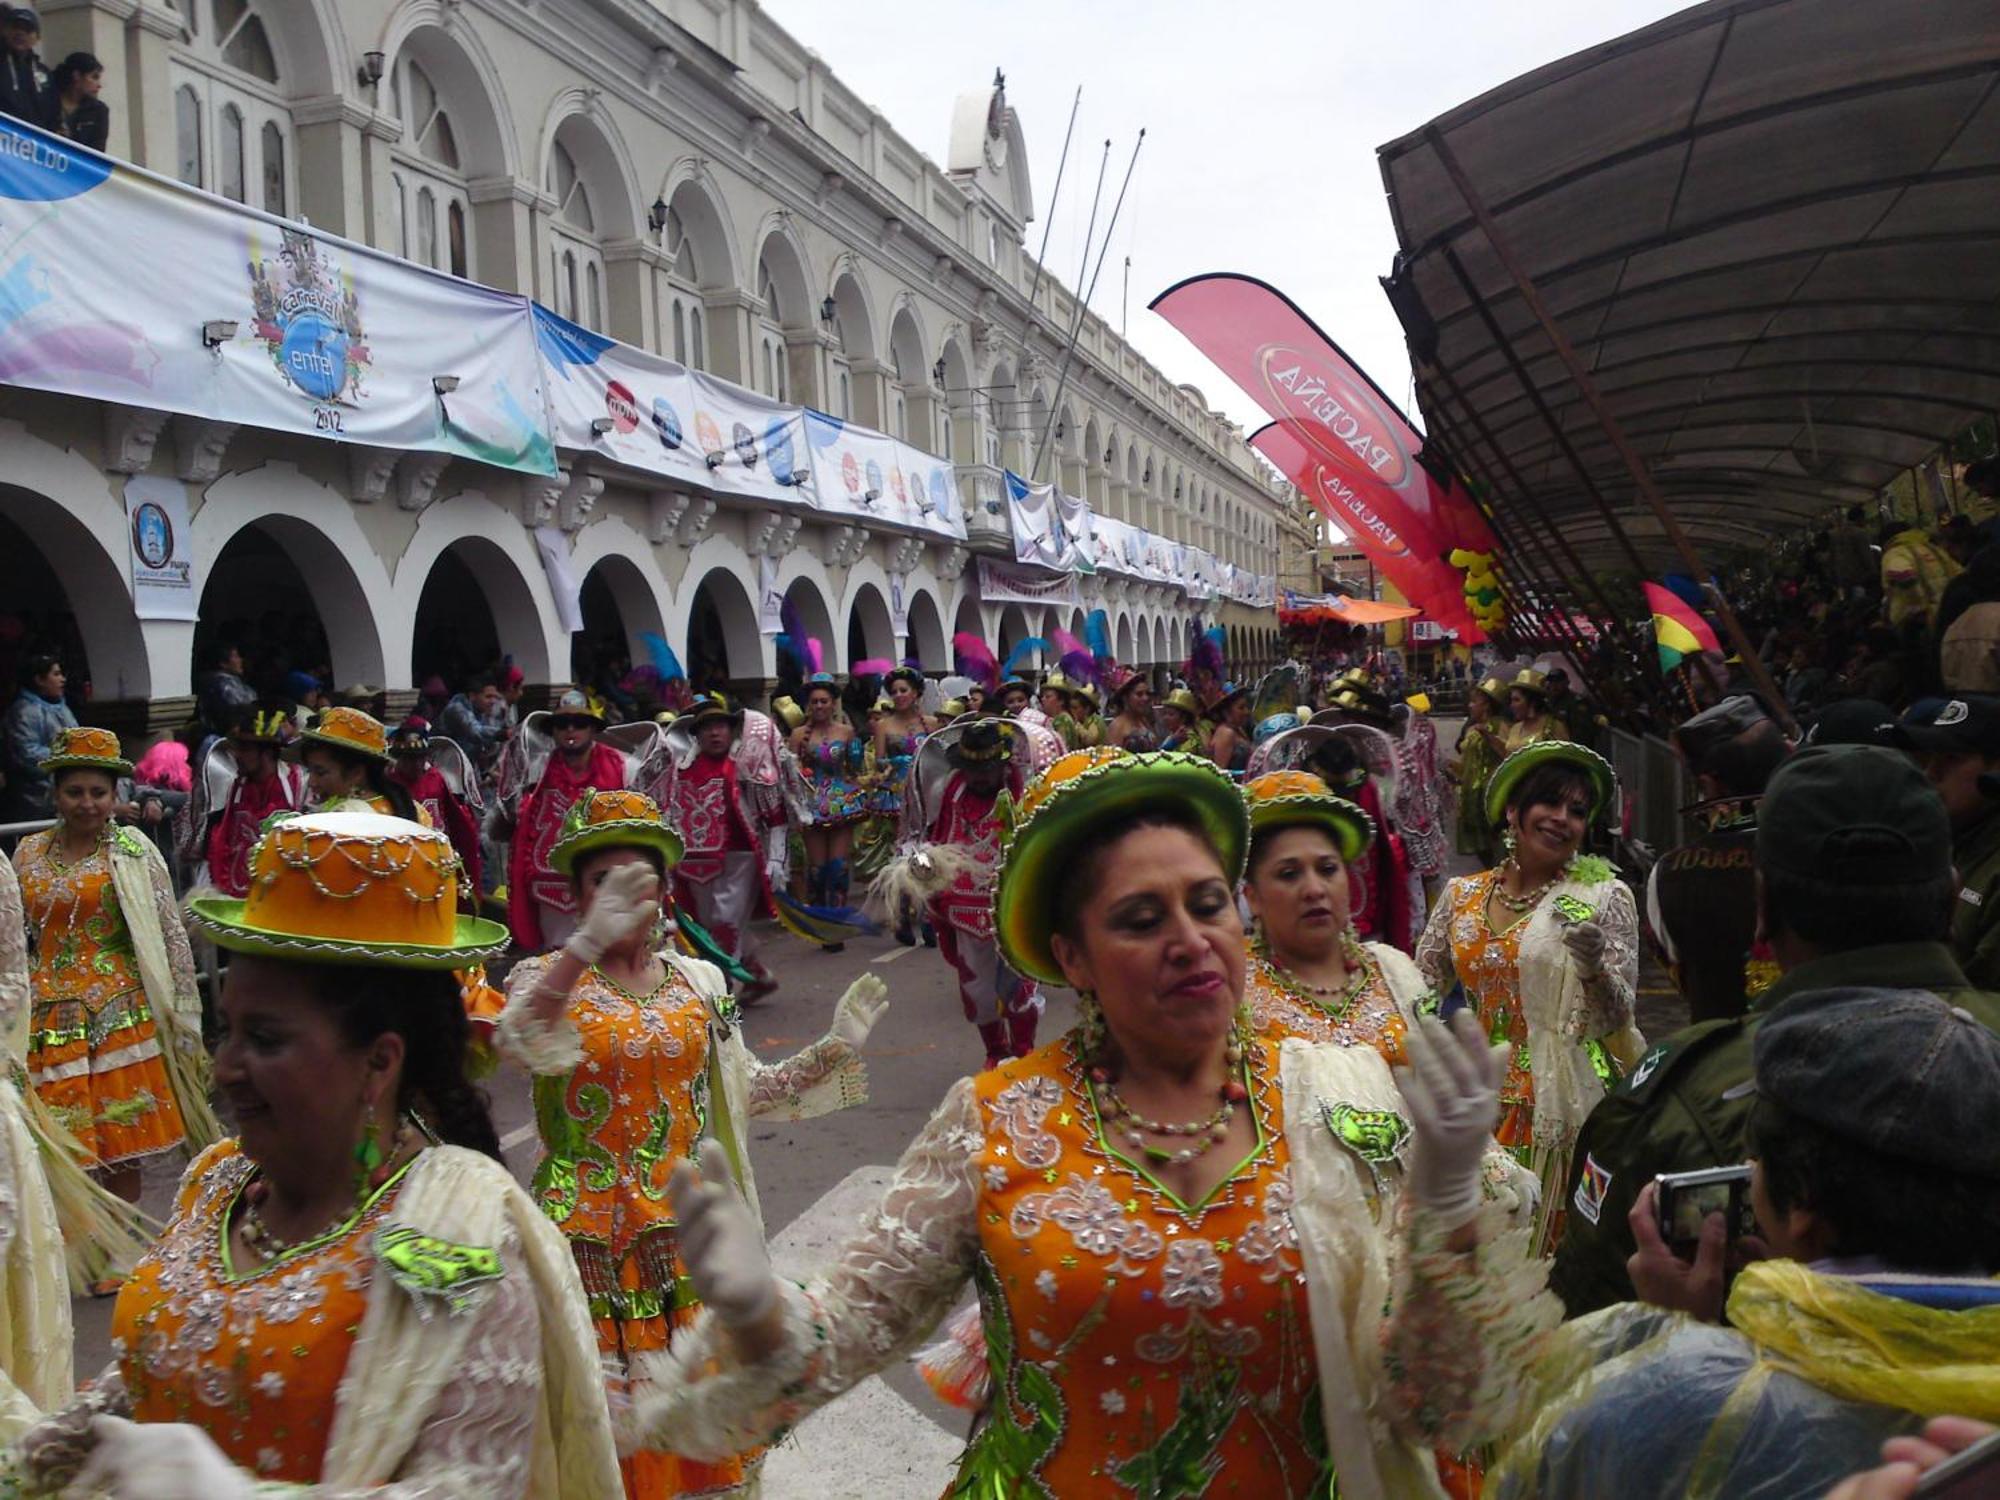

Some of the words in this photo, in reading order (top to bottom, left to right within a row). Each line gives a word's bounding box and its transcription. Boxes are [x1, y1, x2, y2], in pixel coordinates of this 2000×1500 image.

[282, 289, 339, 319] carnaval
[291, 347, 335, 377] entel
[313, 406, 344, 433] 2012
